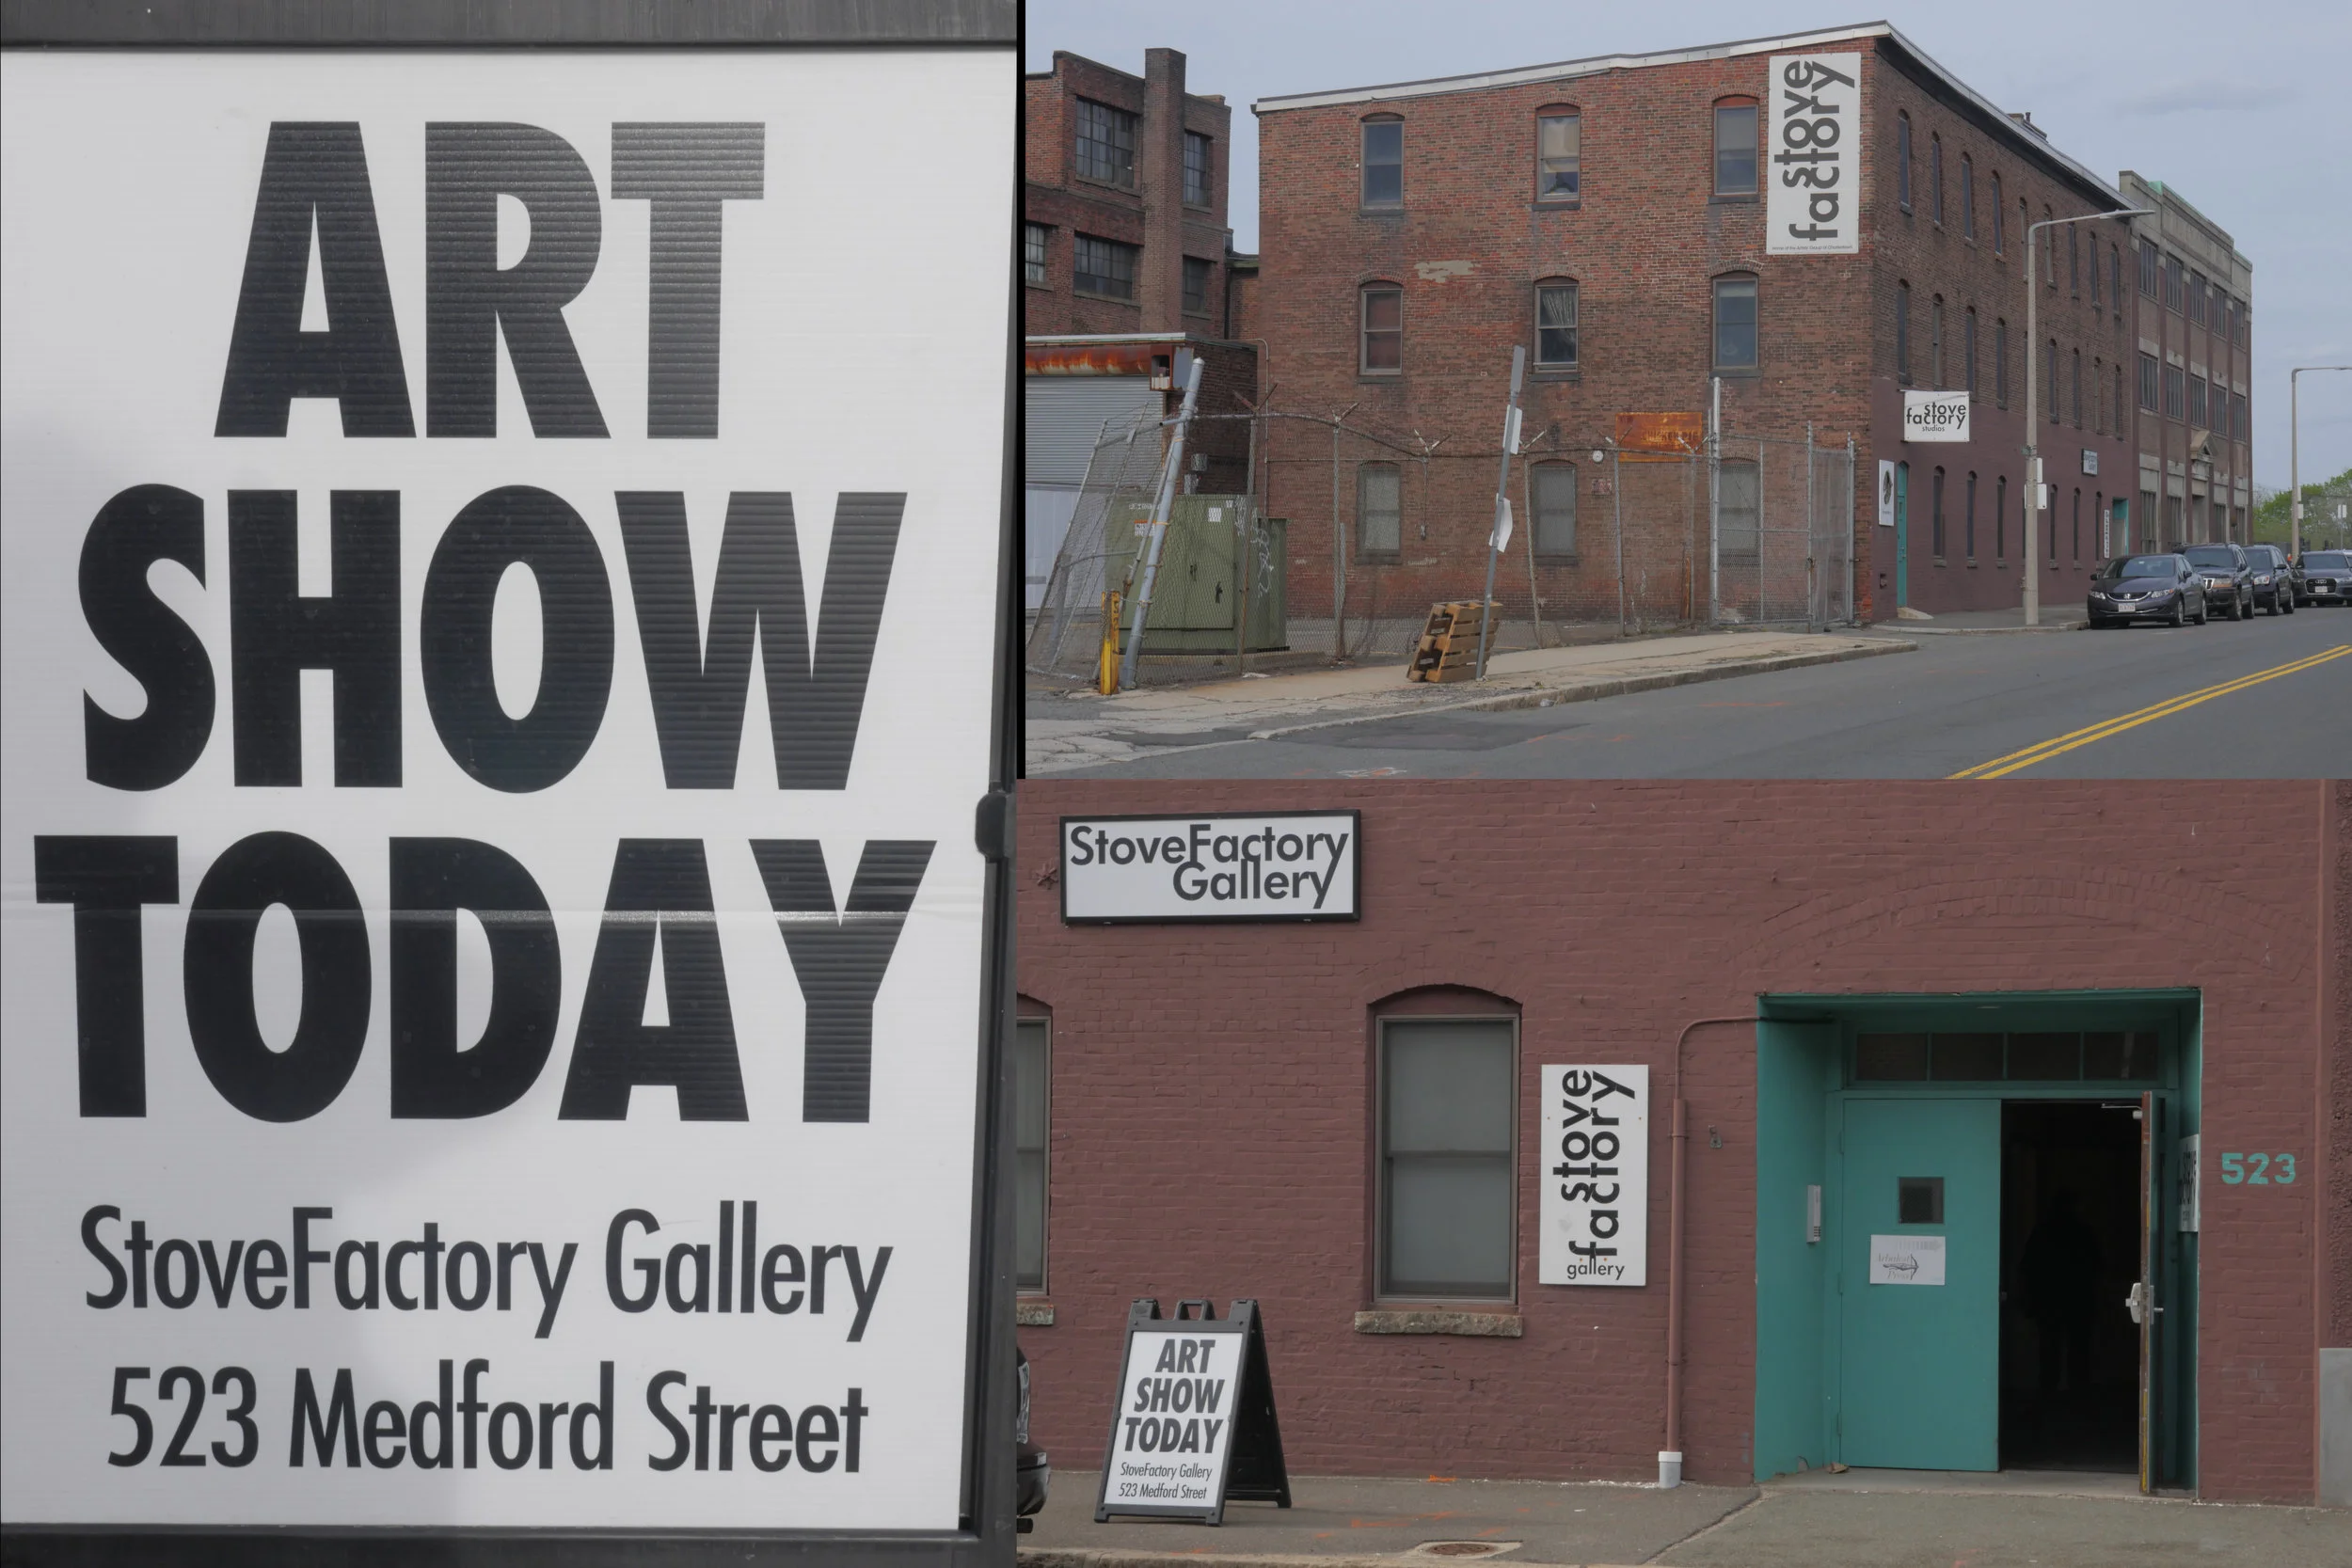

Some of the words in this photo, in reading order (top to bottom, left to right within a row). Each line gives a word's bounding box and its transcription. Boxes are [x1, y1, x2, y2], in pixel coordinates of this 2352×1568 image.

[1774, 60, 1813, 188] stove
[1788, 61, 1855, 241] factory
[215, 121, 766, 438] ART
[1906, 407, 1966, 430] factory
[1924, 402, 1966, 415] stove
[78, 483, 908, 793] SHOW
[1070, 823, 1349, 877] StoveFactory
[1172, 858, 1336, 910] Gallery
[34, 831, 937, 1124] TODAY
[1552, 1069, 1592, 1203] stove
[1568, 1070, 1635, 1257] factory
[2221, 1152, 2296, 1185] 523
[81, 1205, 579, 1338] StoveFactory
[605, 1200, 894, 1342] Gallery
[1566, 1256, 1625, 1280] gallery
[1154, 1338, 1216, 1373] ART
[108, 1367, 259, 1467] 523
[289, 1358, 614, 1470] Medford
[646, 1370, 868, 1473] Street
[1134, 1377, 1226, 1414] SHOW
[1124, 1417, 1224, 1453] TODAY
[1119, 1482, 1137, 1497] 523
[1139, 1482, 1179, 1498] Medford
[1181, 1484, 1207, 1499] Street
[1120, 1462, 1177, 1481] StoveFactory
[1179, 1463, 1213, 1481] Gallery
